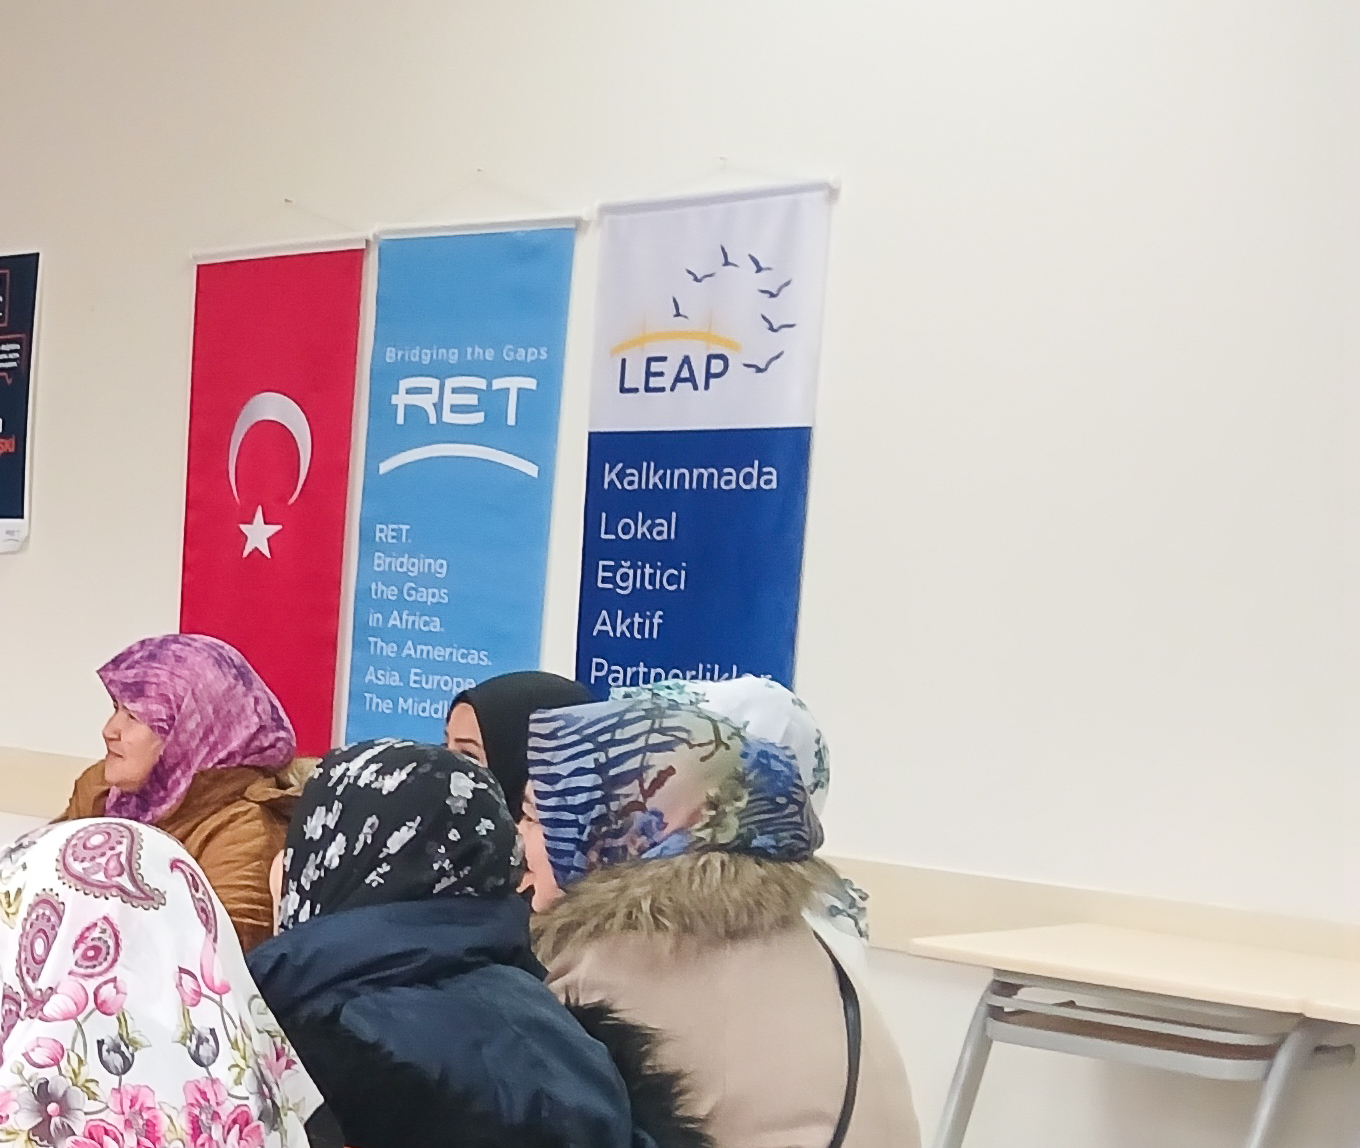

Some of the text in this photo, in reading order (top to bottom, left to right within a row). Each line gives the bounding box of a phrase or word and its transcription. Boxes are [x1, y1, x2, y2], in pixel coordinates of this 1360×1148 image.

[385, 344, 548, 364] Bridging the Gaps
[619, 353, 730, 394] LEAP
[391, 375, 538, 426] RET
[603, 459, 778, 490] Kalkınmada
[375, 524, 412, 544] RET.
[600, 511, 677, 541] Lokal
[373, 552, 448, 578] Bridging
[596, 560, 686, 595] Eğitici
[371, 582, 449, 605] the Gaps
[368, 609, 445, 632] in Africa.
[592, 609, 664, 639] Aktif
[367, 636, 492, 666] The Americas.
[364, 665, 404, 687] Asia.
[363, 692, 448, 720] The Middl
